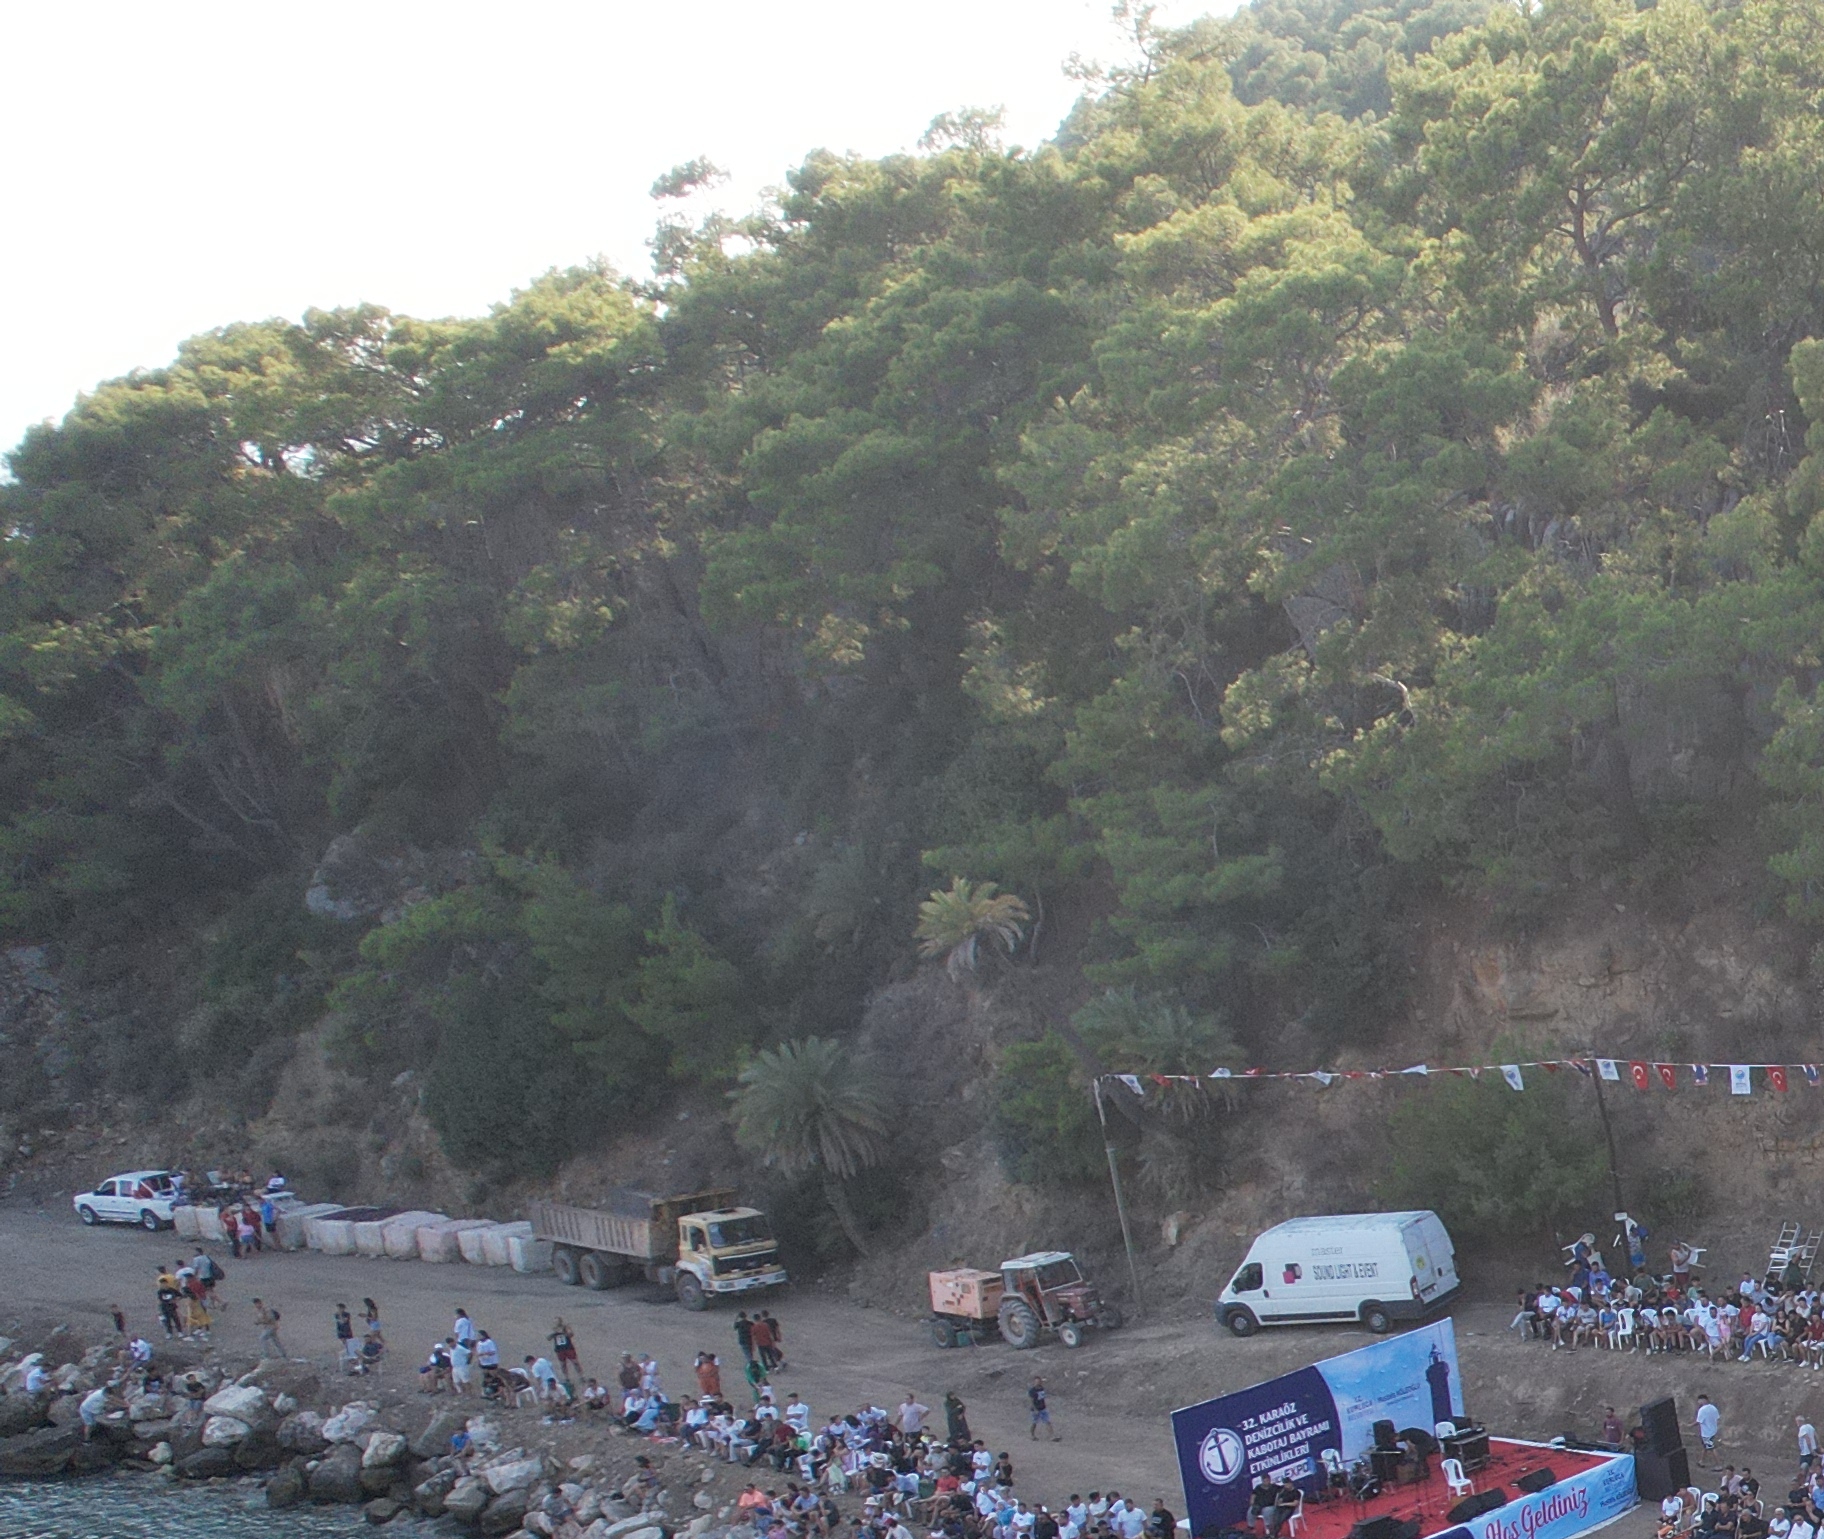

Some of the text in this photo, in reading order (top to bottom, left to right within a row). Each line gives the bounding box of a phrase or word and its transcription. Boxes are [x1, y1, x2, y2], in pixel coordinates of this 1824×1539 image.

[1313, 1265, 1334, 1280] SOUND
[1335, 1264, 1352, 1279] LIGHT
[1359, 1262, 1379, 1278] EVENT
[1241, 1402, 1297, 1431] 32. KARAÖZ
[1245, 1413, 1309, 1445] DENİZCİLİK VE
[1248, 1420, 1330, 1459] KABOTAJ BAYRAMI
[1250, 1441, 1310, 1474] ETKİNLİKLERİ
